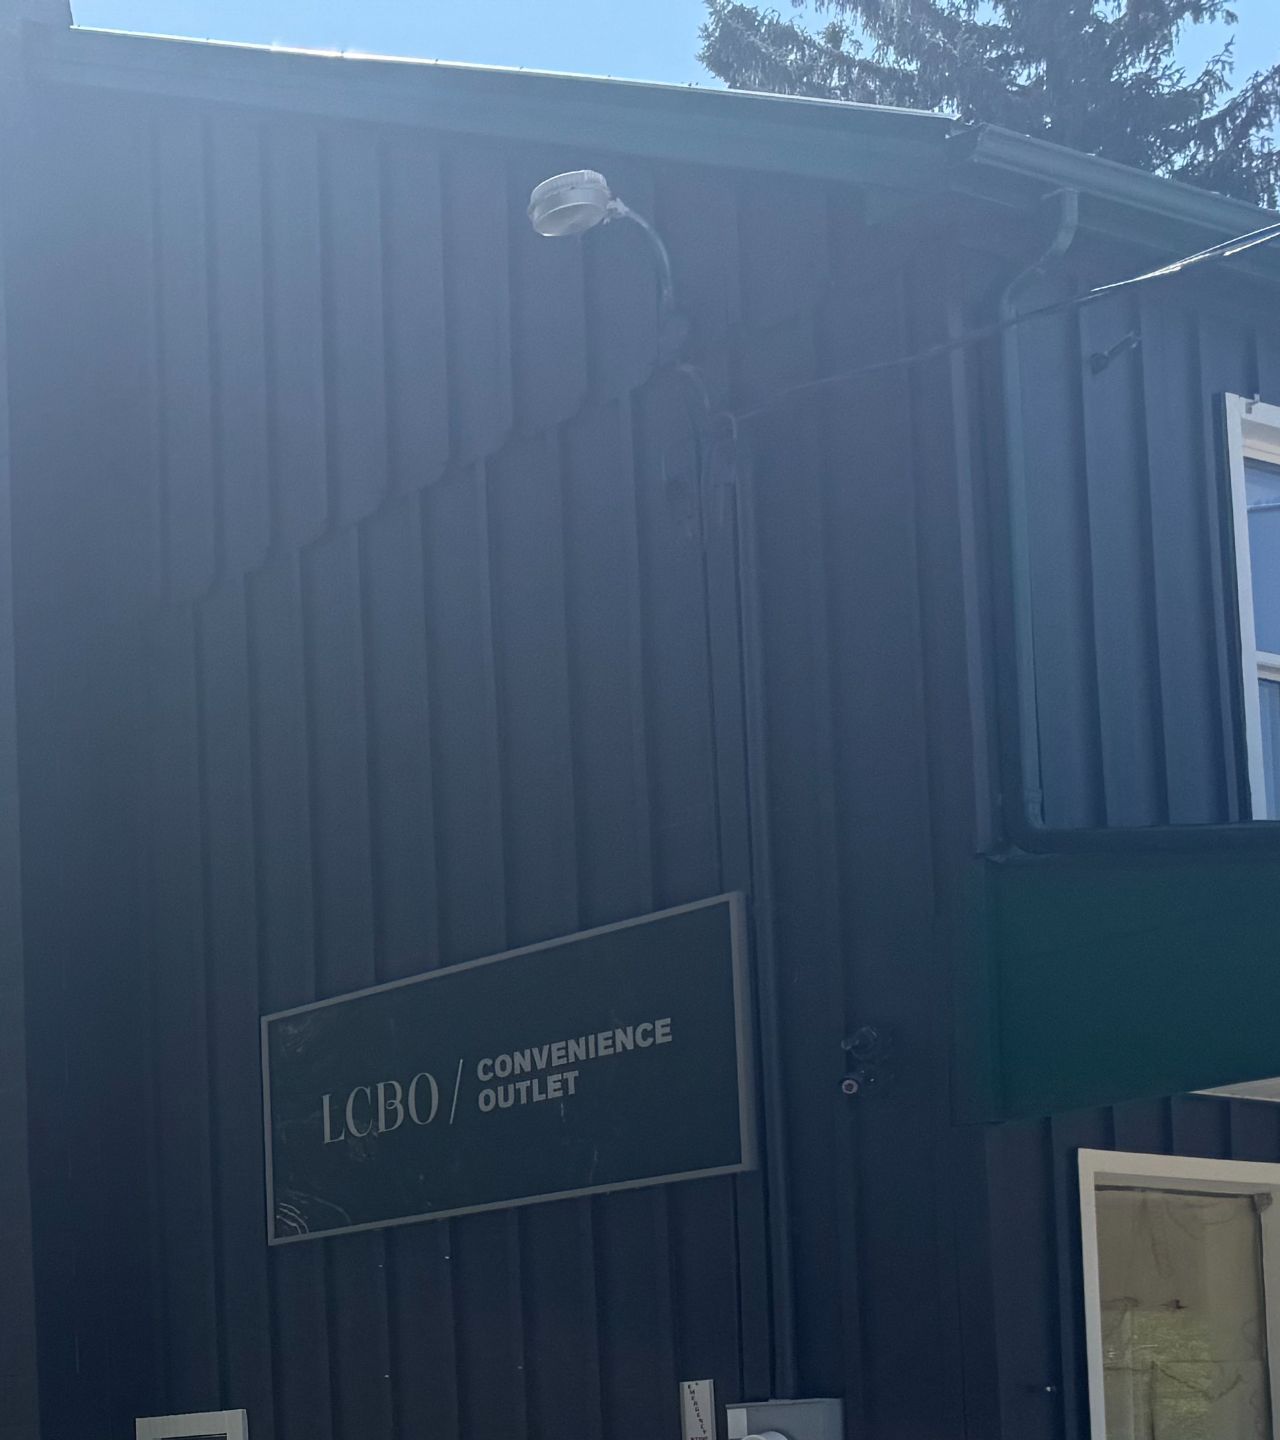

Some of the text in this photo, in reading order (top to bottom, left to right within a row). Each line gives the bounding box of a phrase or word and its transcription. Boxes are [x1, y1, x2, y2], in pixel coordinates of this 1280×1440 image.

[477, 1018, 672, 1082] CONVENIENCE
[322, 1072, 439, 1144] LCBO
[478, 1071, 579, 1112] OUTLET
